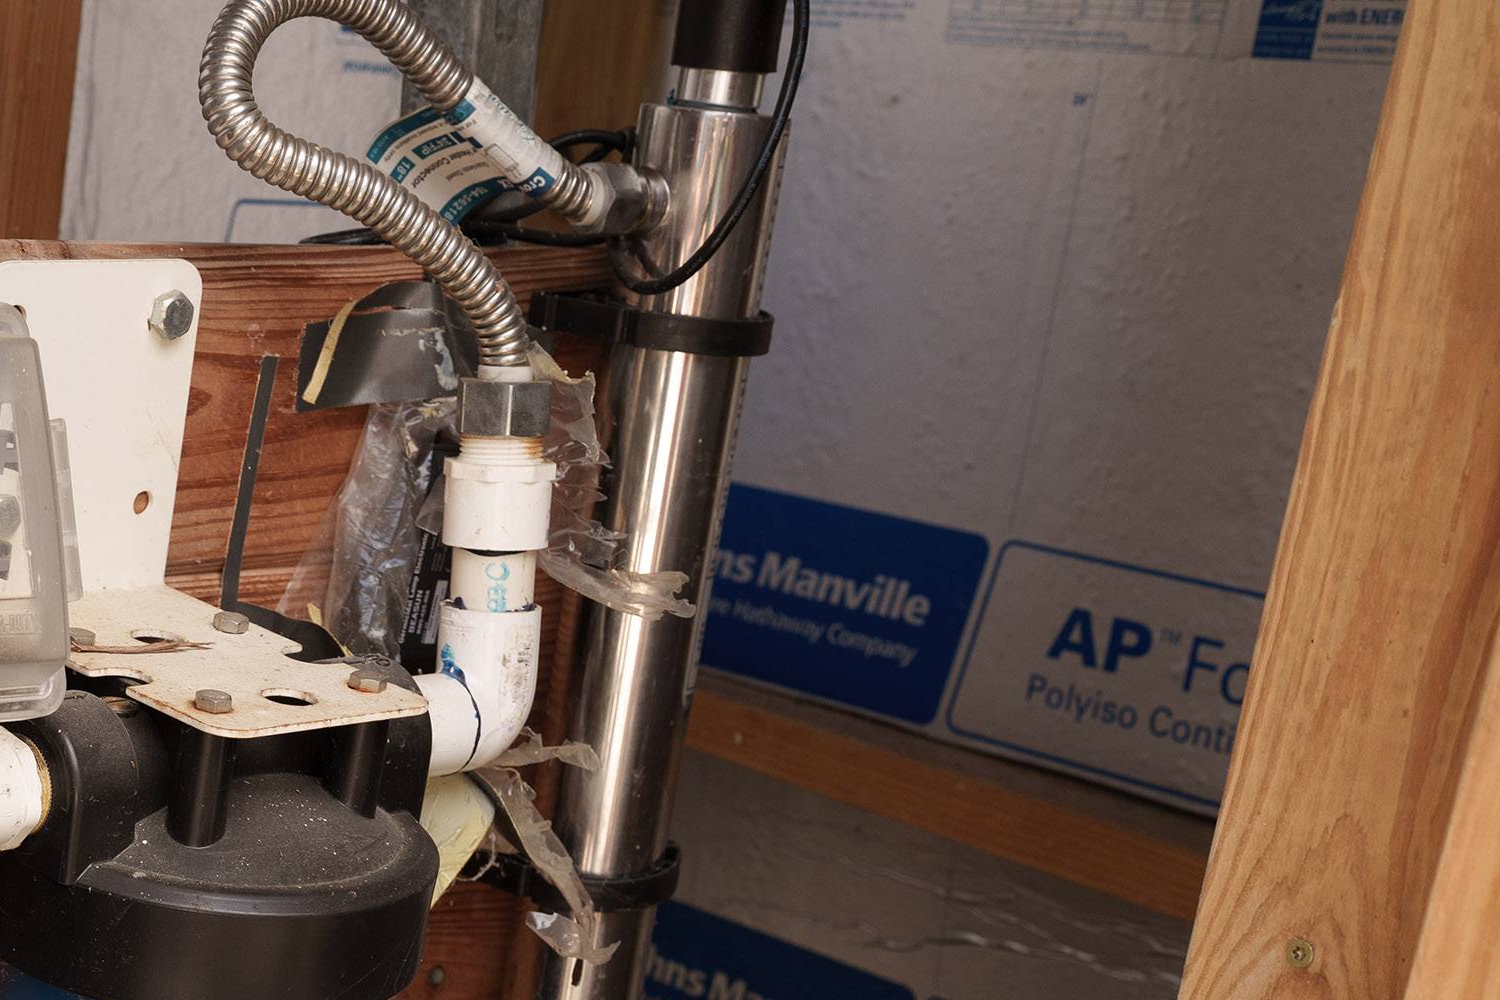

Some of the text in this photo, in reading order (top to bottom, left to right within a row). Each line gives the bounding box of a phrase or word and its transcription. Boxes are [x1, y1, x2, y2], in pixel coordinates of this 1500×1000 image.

[411, 156, 450, 189] Connector
[409, 575, 420, 598] Lamp
[757, 551, 931, 627] Manville
[408, 589, 424, 634] BEASUN
[827, 622, 918, 669] Company
[1025, 671, 1139, 722] Polyiso
